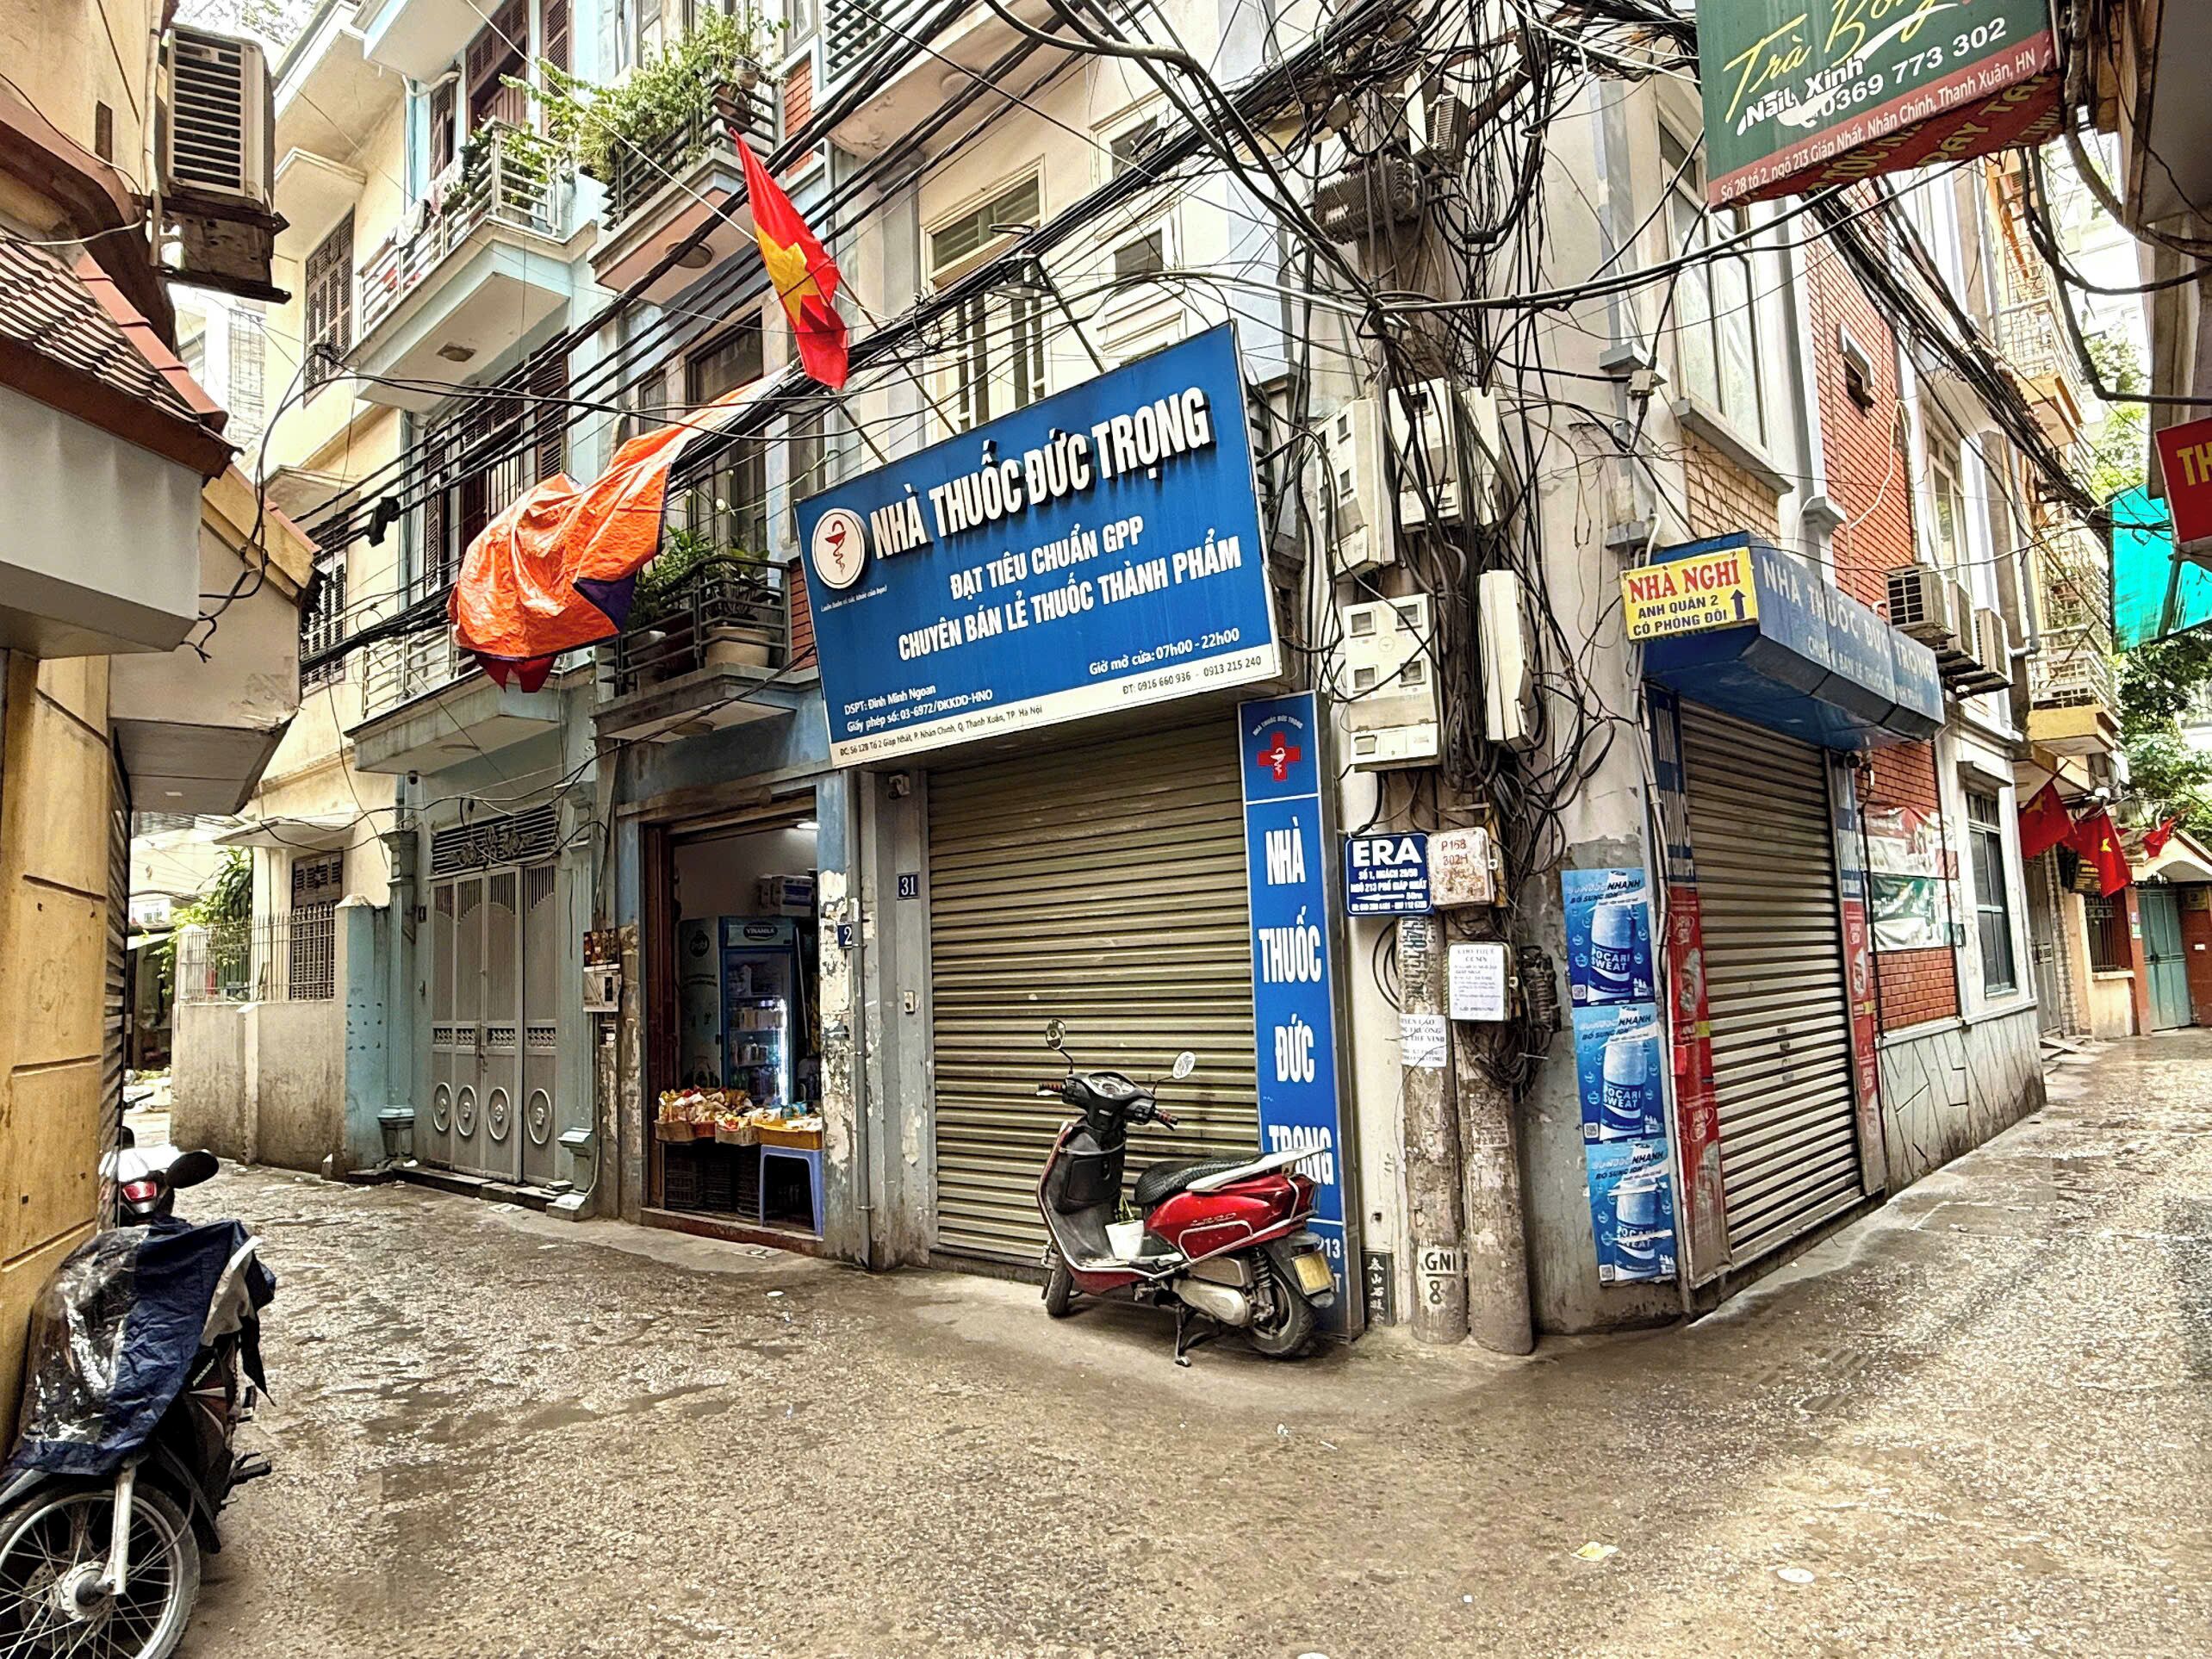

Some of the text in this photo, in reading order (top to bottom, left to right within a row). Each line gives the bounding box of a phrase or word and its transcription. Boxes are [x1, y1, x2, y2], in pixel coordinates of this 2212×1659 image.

[1723, 0, 1936, 123] Trà Bg
[1820, 17, 2007, 116] 0369 773 302
[1746, 56, 1864, 128] Nail Xinh
[1734, 176, 1747, 194] 28
[1770, 156, 1793, 181] ngõ
[1793, 148, 1810, 170] 213
[1811, 139, 1835, 162] Giáp
[1867, 112, 1898, 138] Nhân
[1937, 76, 1976, 107] Thanh
[1978, 63, 2013, 90] Xuân,
[2016, 47, 2036, 74] HN
[870, 387, 1211, 560] NHÀ THUỐC ĐỨC TRỌNG
[949, 515, 1144, 601] ĐẠT TIÊU CHUẨN GPP
[898, 527, 1242, 662] CHUYÊN BÁN LẺ THUỐC THÀNH PHẨM
[1627, 565, 1679, 604] NHÀ
[1762, 556, 1803, 607] NHÀ
[1637, 594, 1719, 619] ANH QUÂN 2
[1704, 608, 1728, 623] ĐÔI
[1089, 660, 1109, 676] Giờ
[1110, 654, 1129, 670] mở
[1155, 638, 1193, 661] 07h00
[1201, 627, 1240, 649] 22h00
[1137, 678, 1158, 692] 0916
[1159, 675, 1174, 687] 660
[1175, 671, 1191, 683] 936
[1203, 662, 1225, 677] 0913
[1227, 659, 1243, 673] 215
[1245, 656, 1262, 668] 240
[843, 700, 868, 716] DSPT:
[887, 690, 908, 705] Minh
[909, 685, 937, 701] Ngoan
[847, 718, 864, 734] Giấy
[866, 715, 886, 731] phép
[965, 718, 985, 730] Thanh
[1265, 816, 1307, 885] NHÀ
[1352, 837, 1423, 868] ERA
[900, 876, 916, 896] 31
[1364, 882, 1377, 892] 213
[843, 926, 853, 946] 2
[1258, 904, 1322, 984] THUỐC
[1274, 1013, 1315, 1083] ĐỨC
[1429, 1280, 1443, 1305] 8
